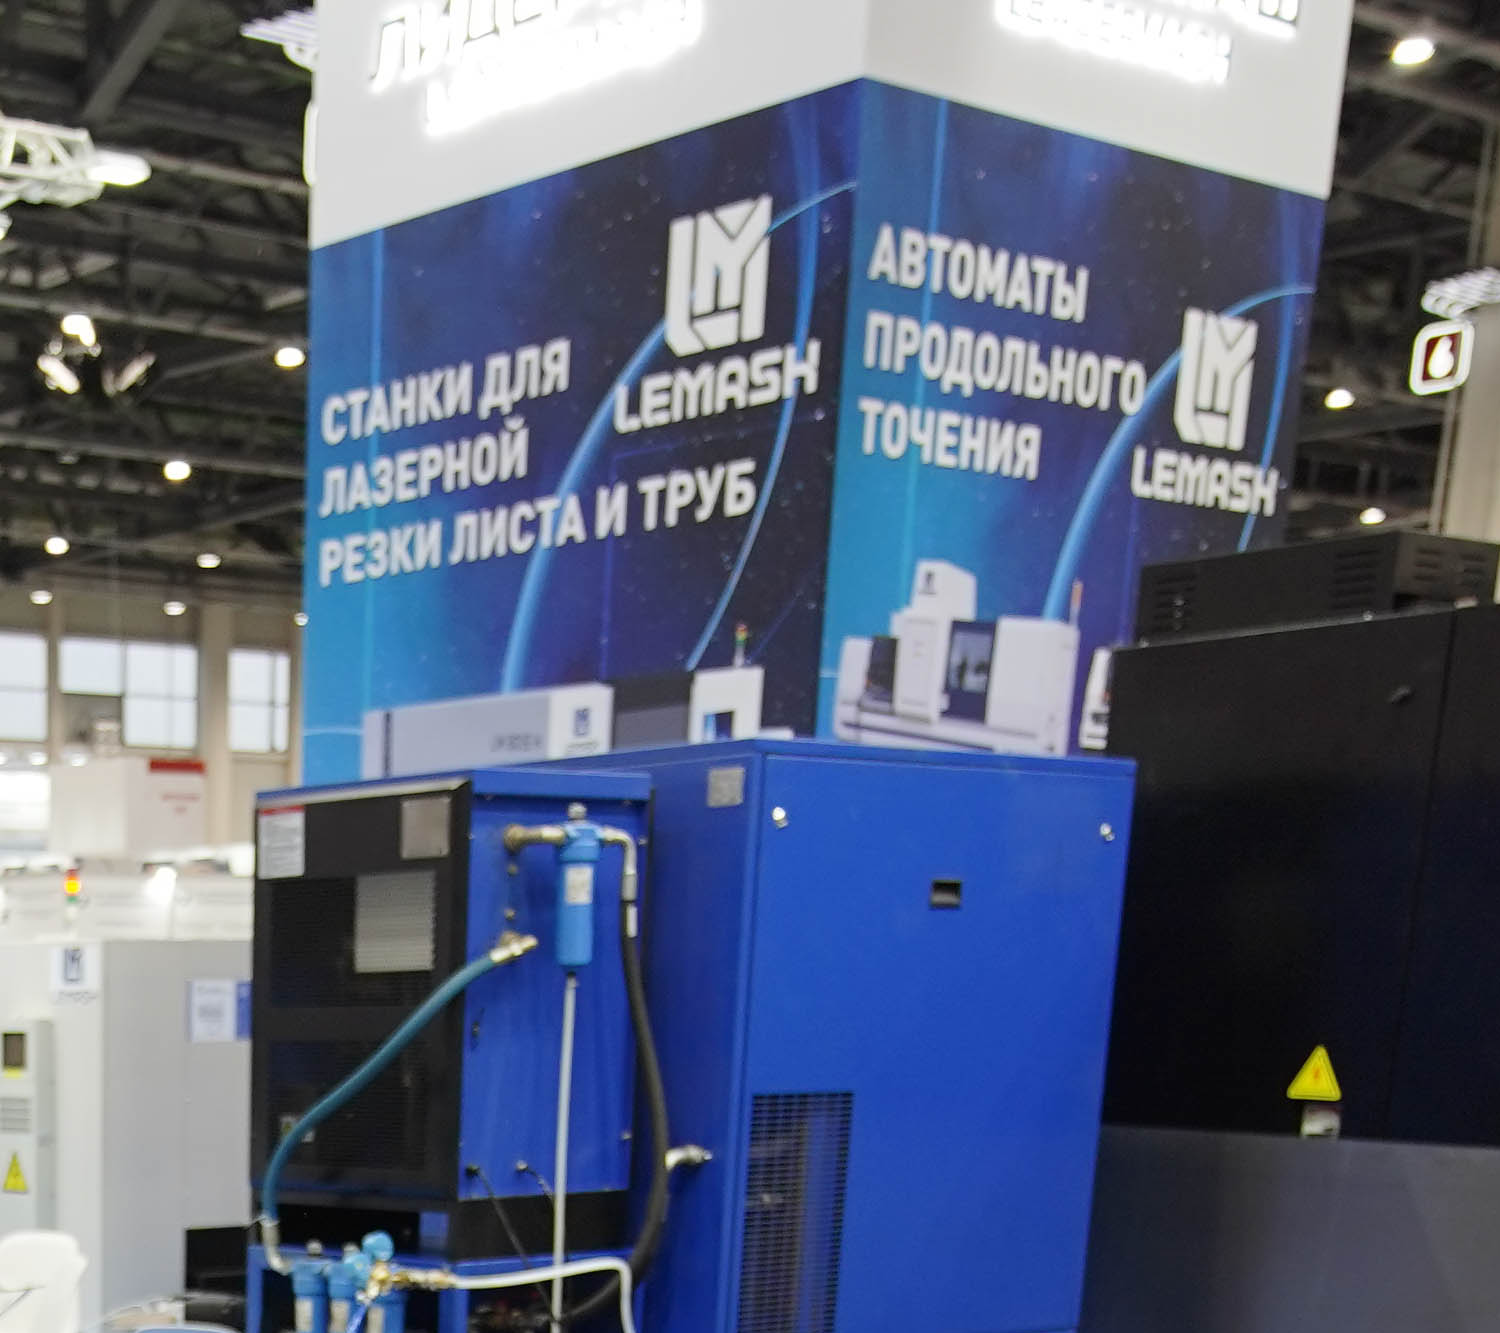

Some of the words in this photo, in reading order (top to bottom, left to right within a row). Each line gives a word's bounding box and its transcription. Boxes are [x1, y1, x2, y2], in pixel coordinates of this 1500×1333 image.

[868, 223, 1089, 323] АВТОМАТЫ
[321, 362, 473, 446] СТАНКИ
[478, 337, 571, 420] ДЛЯ
[613, 337, 821, 434] LEMASH
[863, 310, 1147, 416] ПРОДОЛЬНОГО
[318, 414, 529, 519] ЛАЗЕРНОЙ
[858, 396, 1042, 481] ТОЧЕНИЯ
[1131, 446, 1280, 518] LEMASH
[319, 520, 442, 588] РЕЗКИ
[448, 492, 587, 566] ЛИСТА
[594, 482, 627, 540] И
[637, 458, 757, 532] ТРУБ
